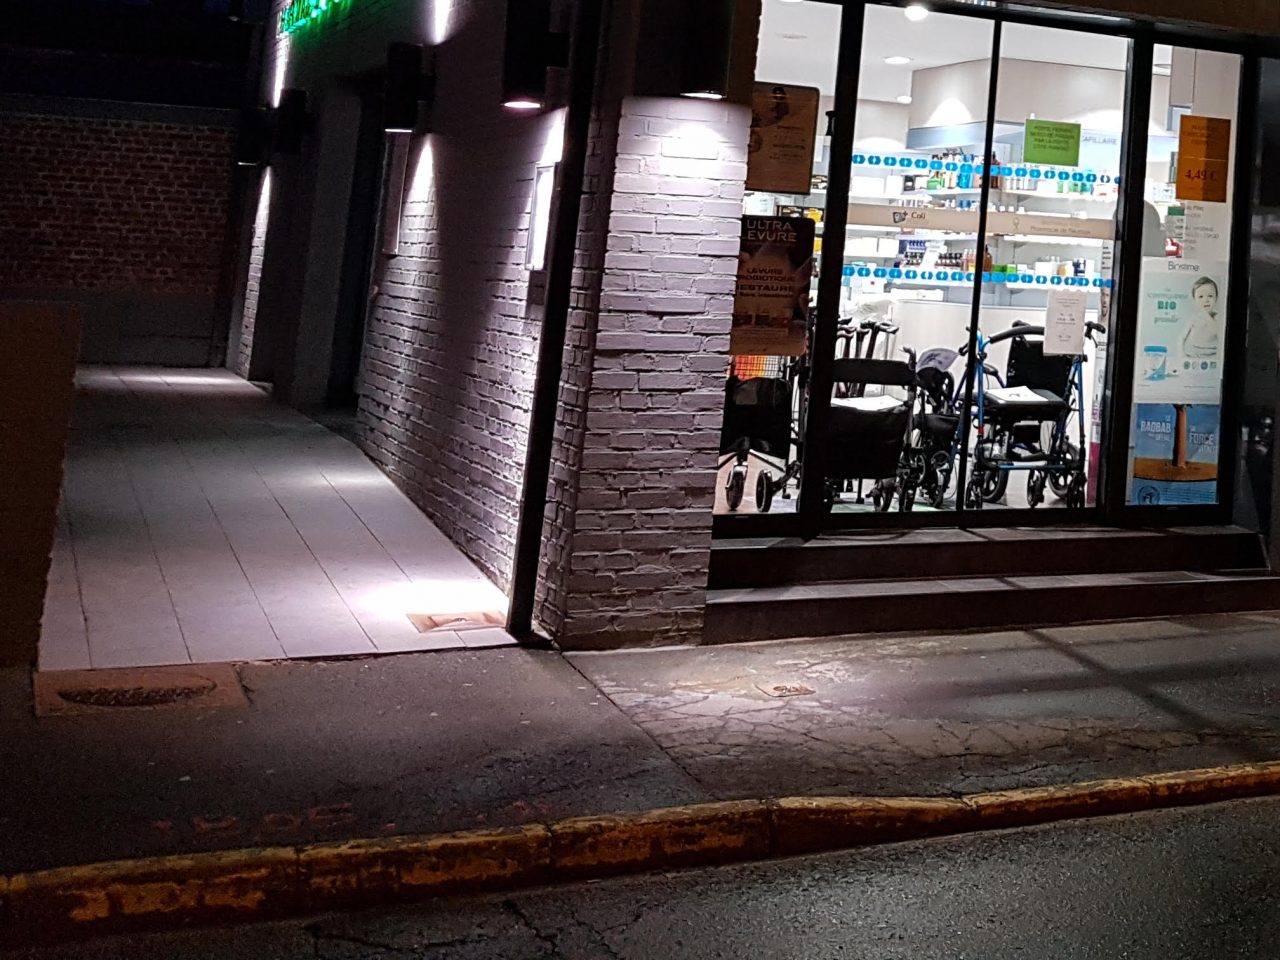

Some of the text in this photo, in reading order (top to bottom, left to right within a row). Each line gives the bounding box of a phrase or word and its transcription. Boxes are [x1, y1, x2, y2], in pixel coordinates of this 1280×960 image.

[746, 220, 793, 231] ULTRA
[737, 274, 796, 282] ROBIOTIQUE
[738, 283, 794, 292] ESTAURE
[1157, 300, 1177, 310] BIO
[1140, 420, 1172, 433] BAOBAB
